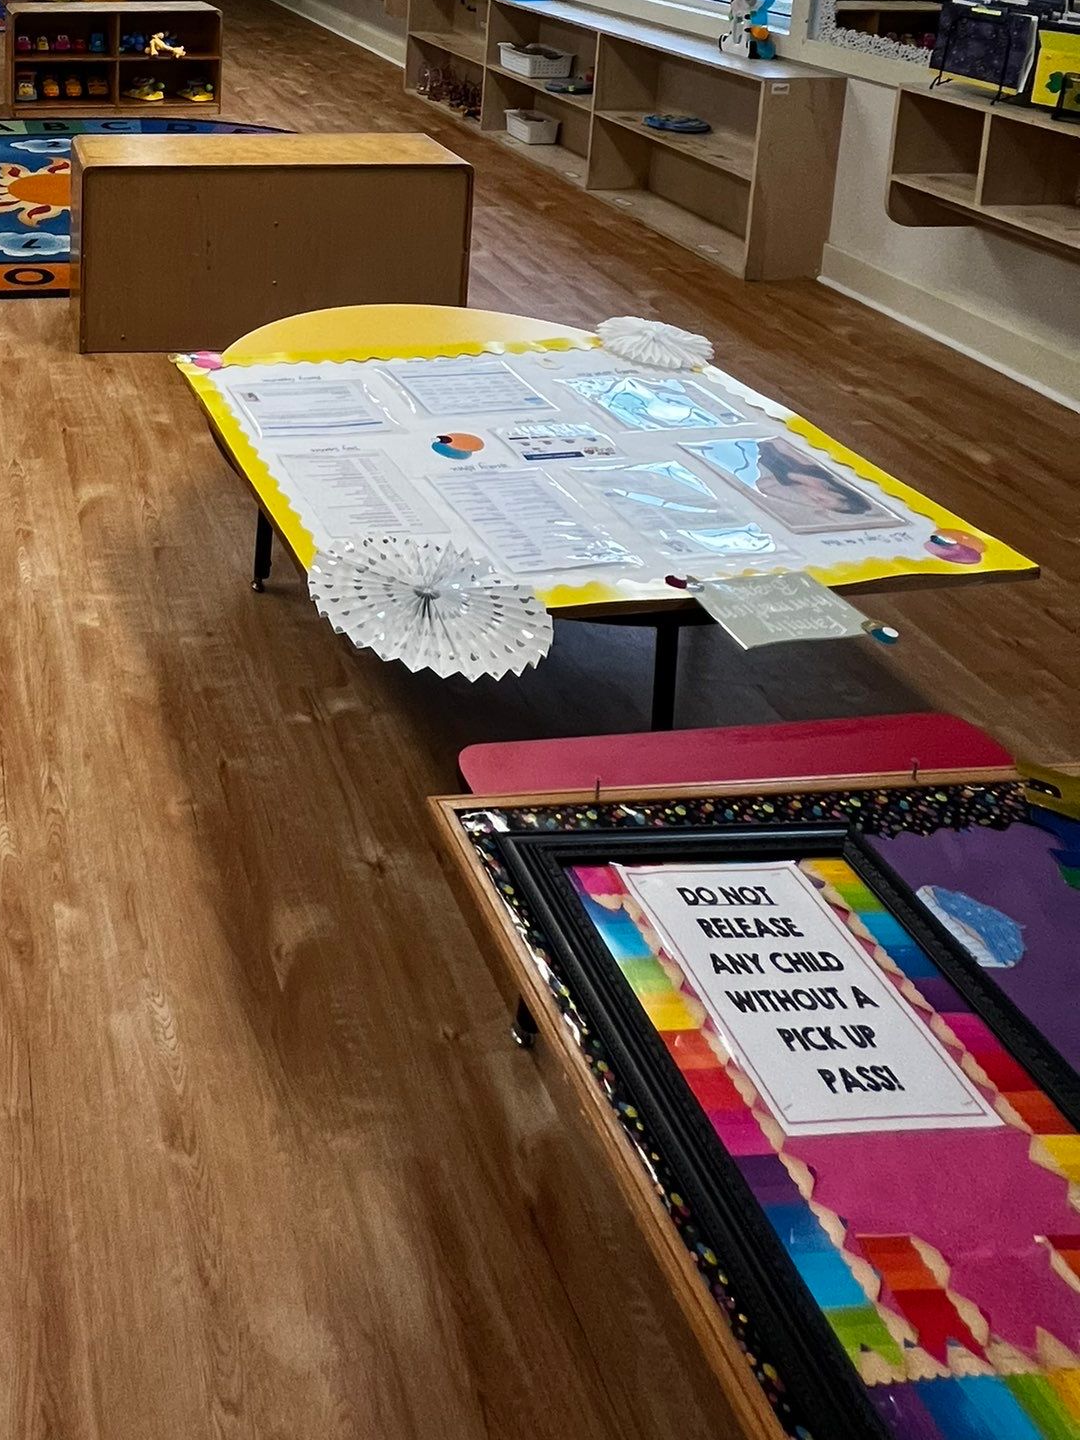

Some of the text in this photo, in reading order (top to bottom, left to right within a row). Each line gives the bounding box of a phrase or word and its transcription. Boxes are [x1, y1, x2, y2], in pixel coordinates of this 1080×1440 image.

[4, 267, 55, 285] O
[42, 122, 70, 131] B
[101, 121, 134, 131] C
[166, 122, 198, 132] D
[22, 238, 41, 249] 7
[676, 886, 776, 906] DO NOT
[696, 917, 804, 938] RELEASE
[710, 951, 844, 975] ANY CHILD
[725, 985, 880, 1013] WITHOUT A
[777, 1024, 877, 1052] PICK UP
[817, 1065, 906, 1094] PASS!
